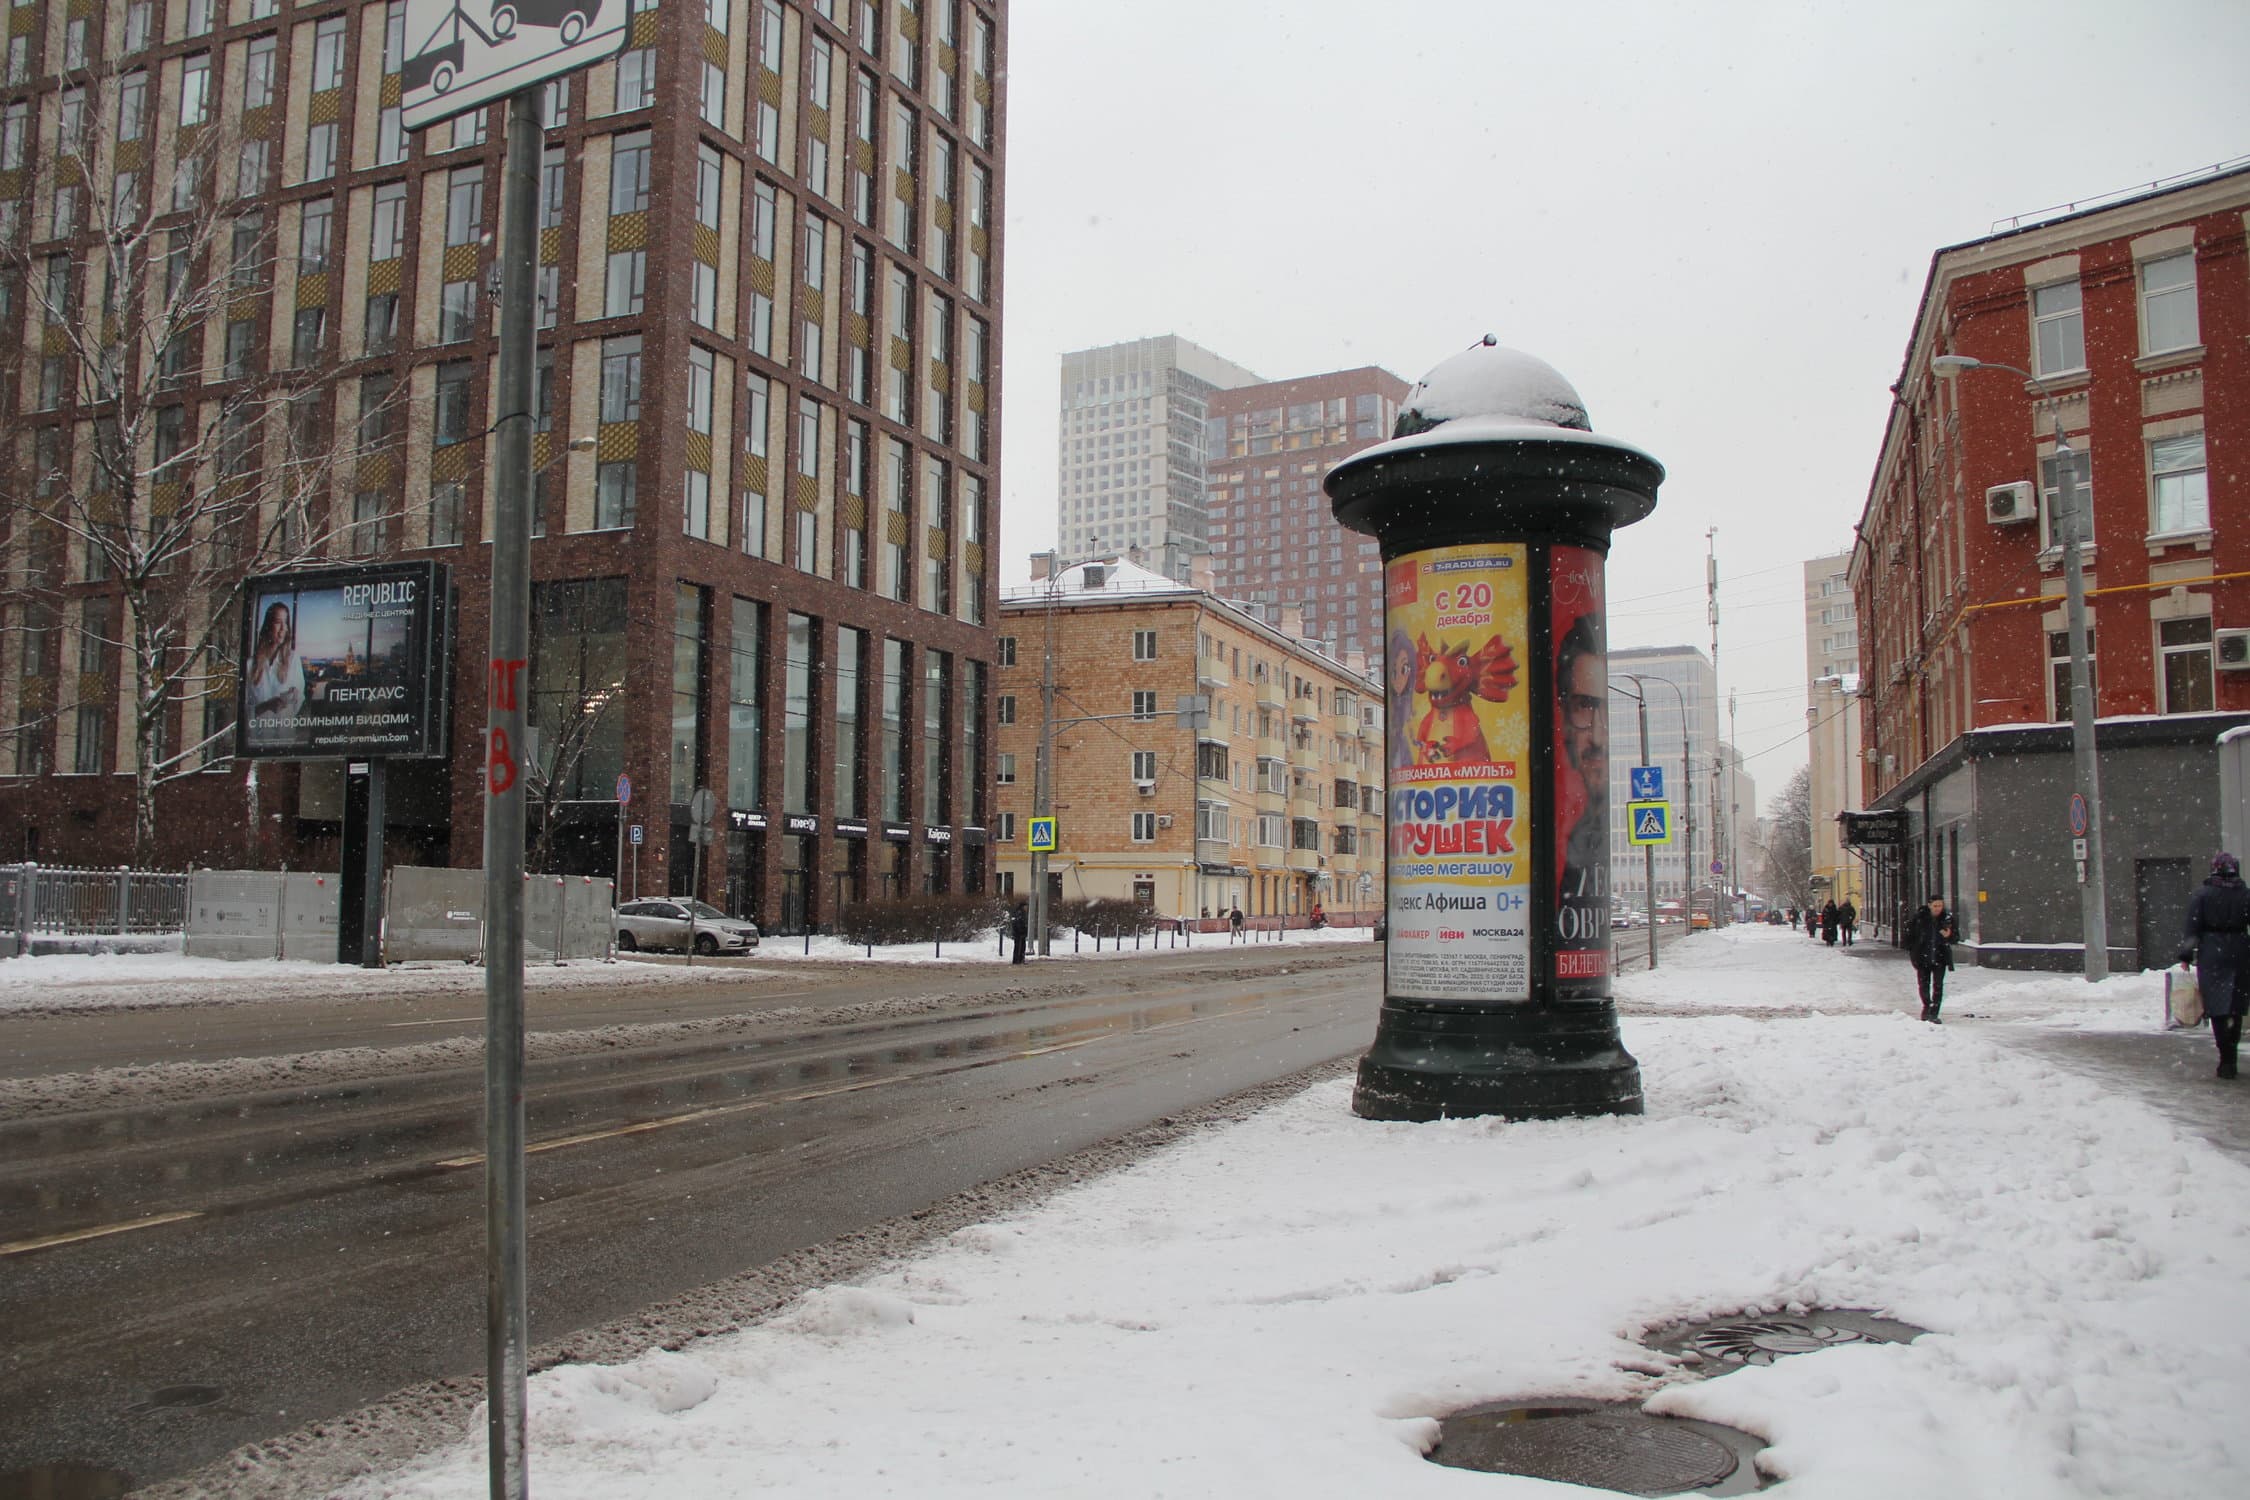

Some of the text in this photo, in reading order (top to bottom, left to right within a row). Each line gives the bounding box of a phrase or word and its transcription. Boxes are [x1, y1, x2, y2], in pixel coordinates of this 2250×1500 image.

[343, 580, 416, 607] REPUBLIC
[1456, 584, 1493, 608] 20
[381, 608, 415, 618] ЦЕНТРОМ
[1436, 612, 1491, 628] декабря
[329, 687, 406, 703] ПЕНТХАУС
[258, 716, 354, 730] панорамными
[356, 712, 410, 725] видами
[314, 733, 409, 745] republic-premium.com
[1454, 764, 1514, 778] «МУЛЬТ»
[1437, 861, 1513, 879] мегашоу
[1425, 892, 1487, 914] Афиша
[1496, 892, 1524, 912] 0+
[1472, 928, 1524, 937] МОСКВА24
